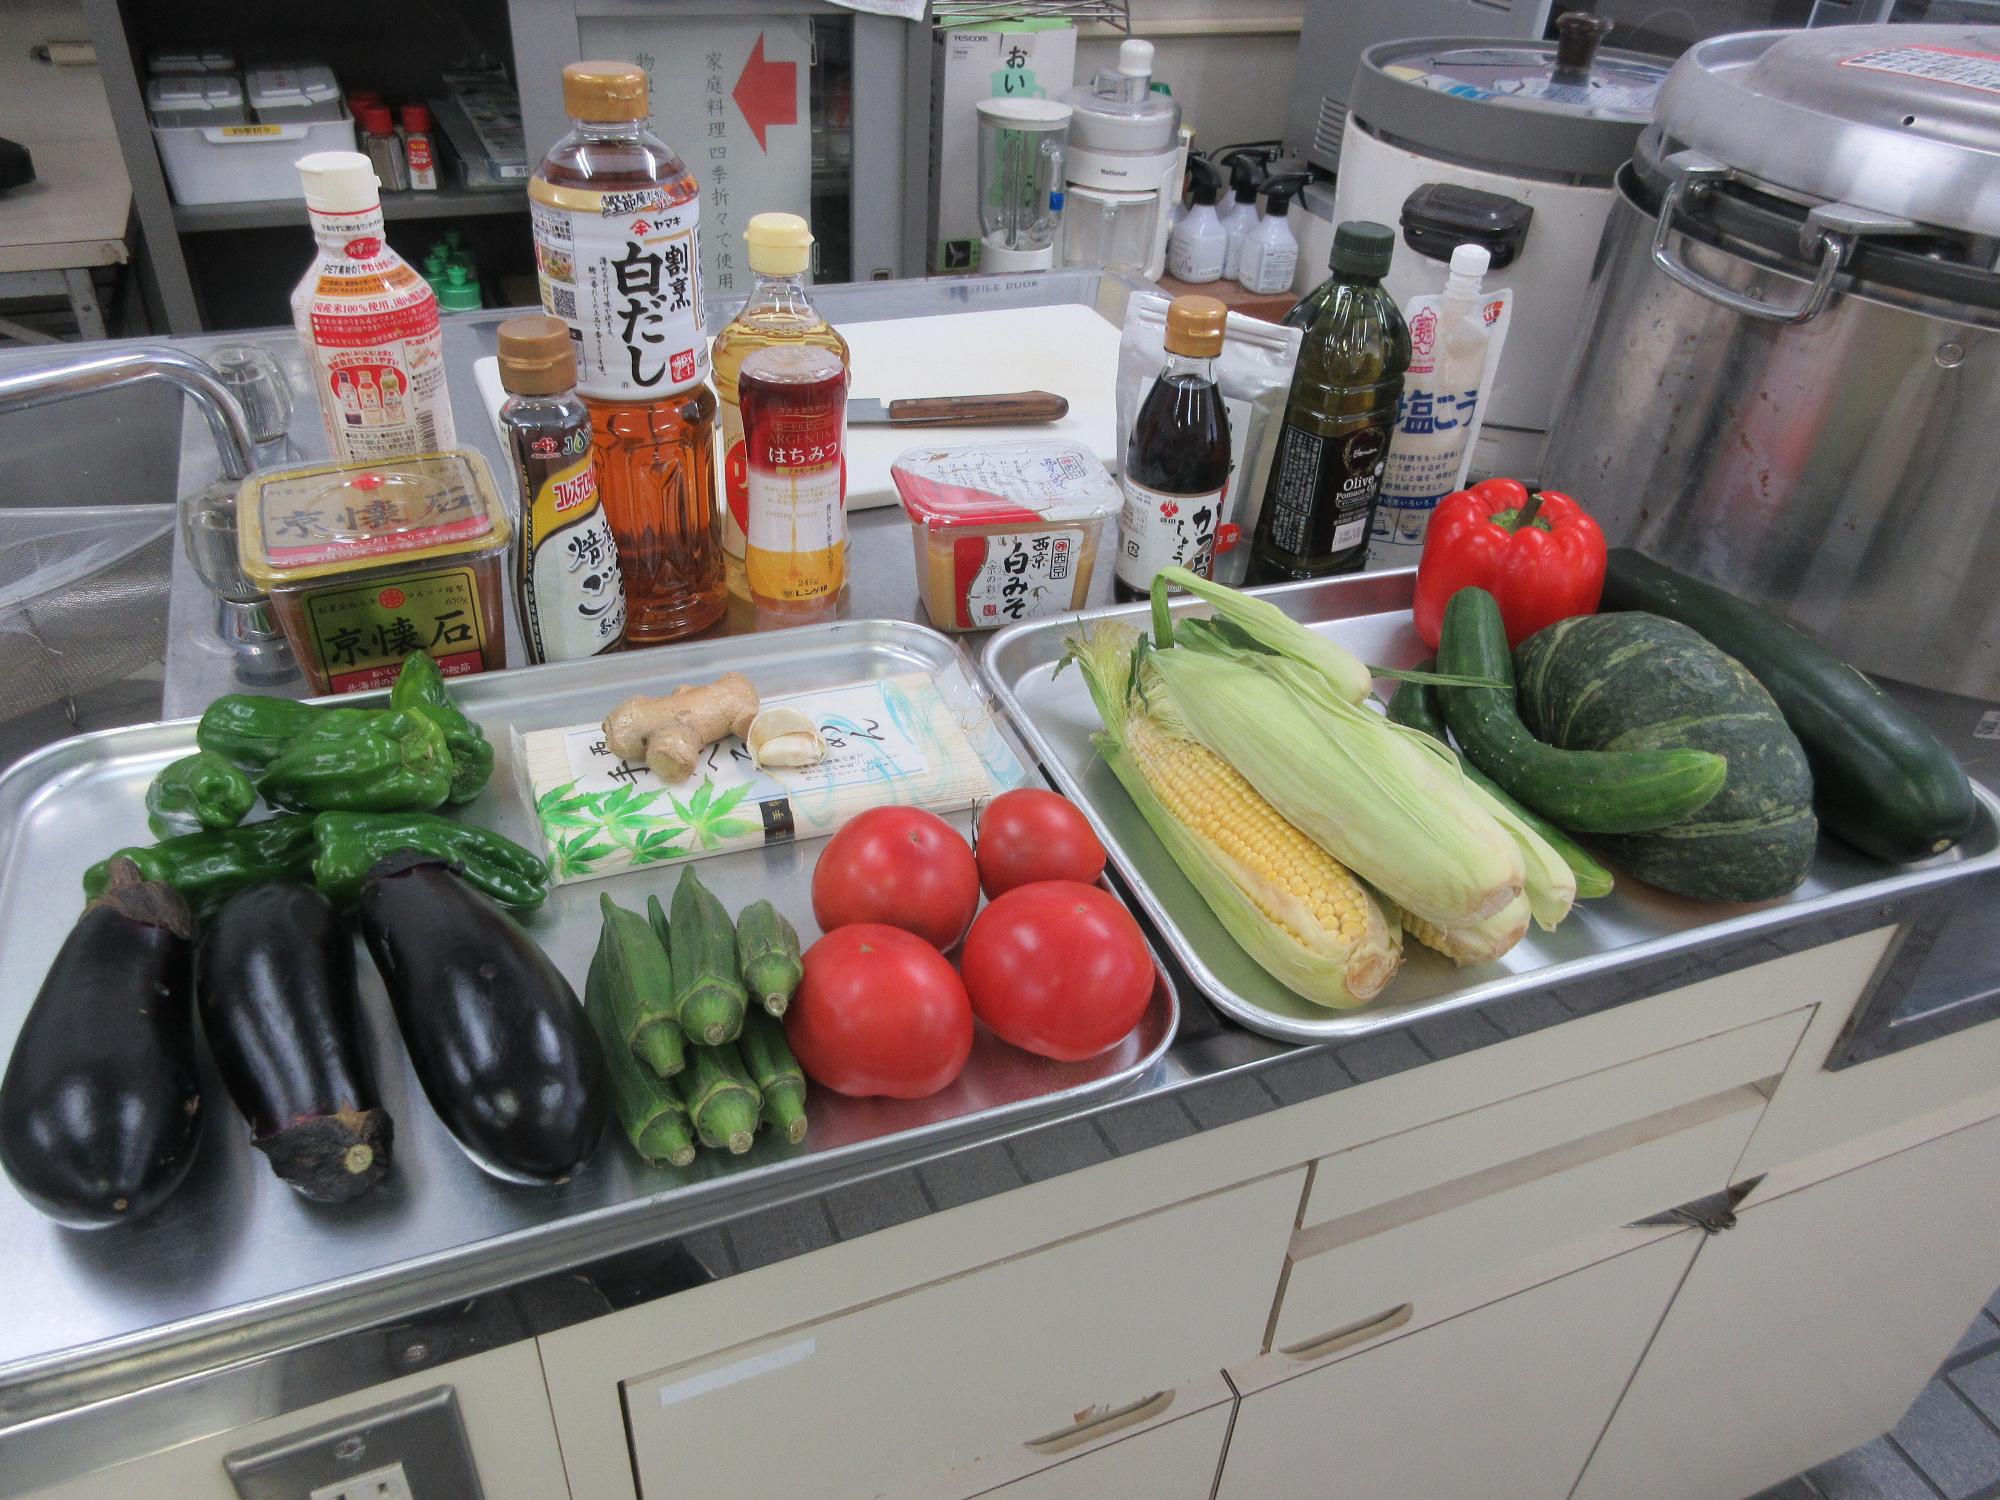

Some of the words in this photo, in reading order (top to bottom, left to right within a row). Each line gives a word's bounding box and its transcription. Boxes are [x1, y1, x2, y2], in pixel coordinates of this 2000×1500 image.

[705, 52, 734, 290] 家庭料理四季折々で使用
[1100, 168, 1128, 178] National
[654, 216, 681, 230] ヤマキ
[664, 243, 691, 313] 割烹
[611, 241, 667, 388] 白だし
[769, 442, 837, 465] はちみつ
[1336, 488, 1365, 501] Pomace
[1343, 475, 1375, 492] Olive
[1032, 536, 1051, 570] 西京
[1002, 541, 1029, 620] 白みそ
[324, 609, 474, 666] 京懐石
